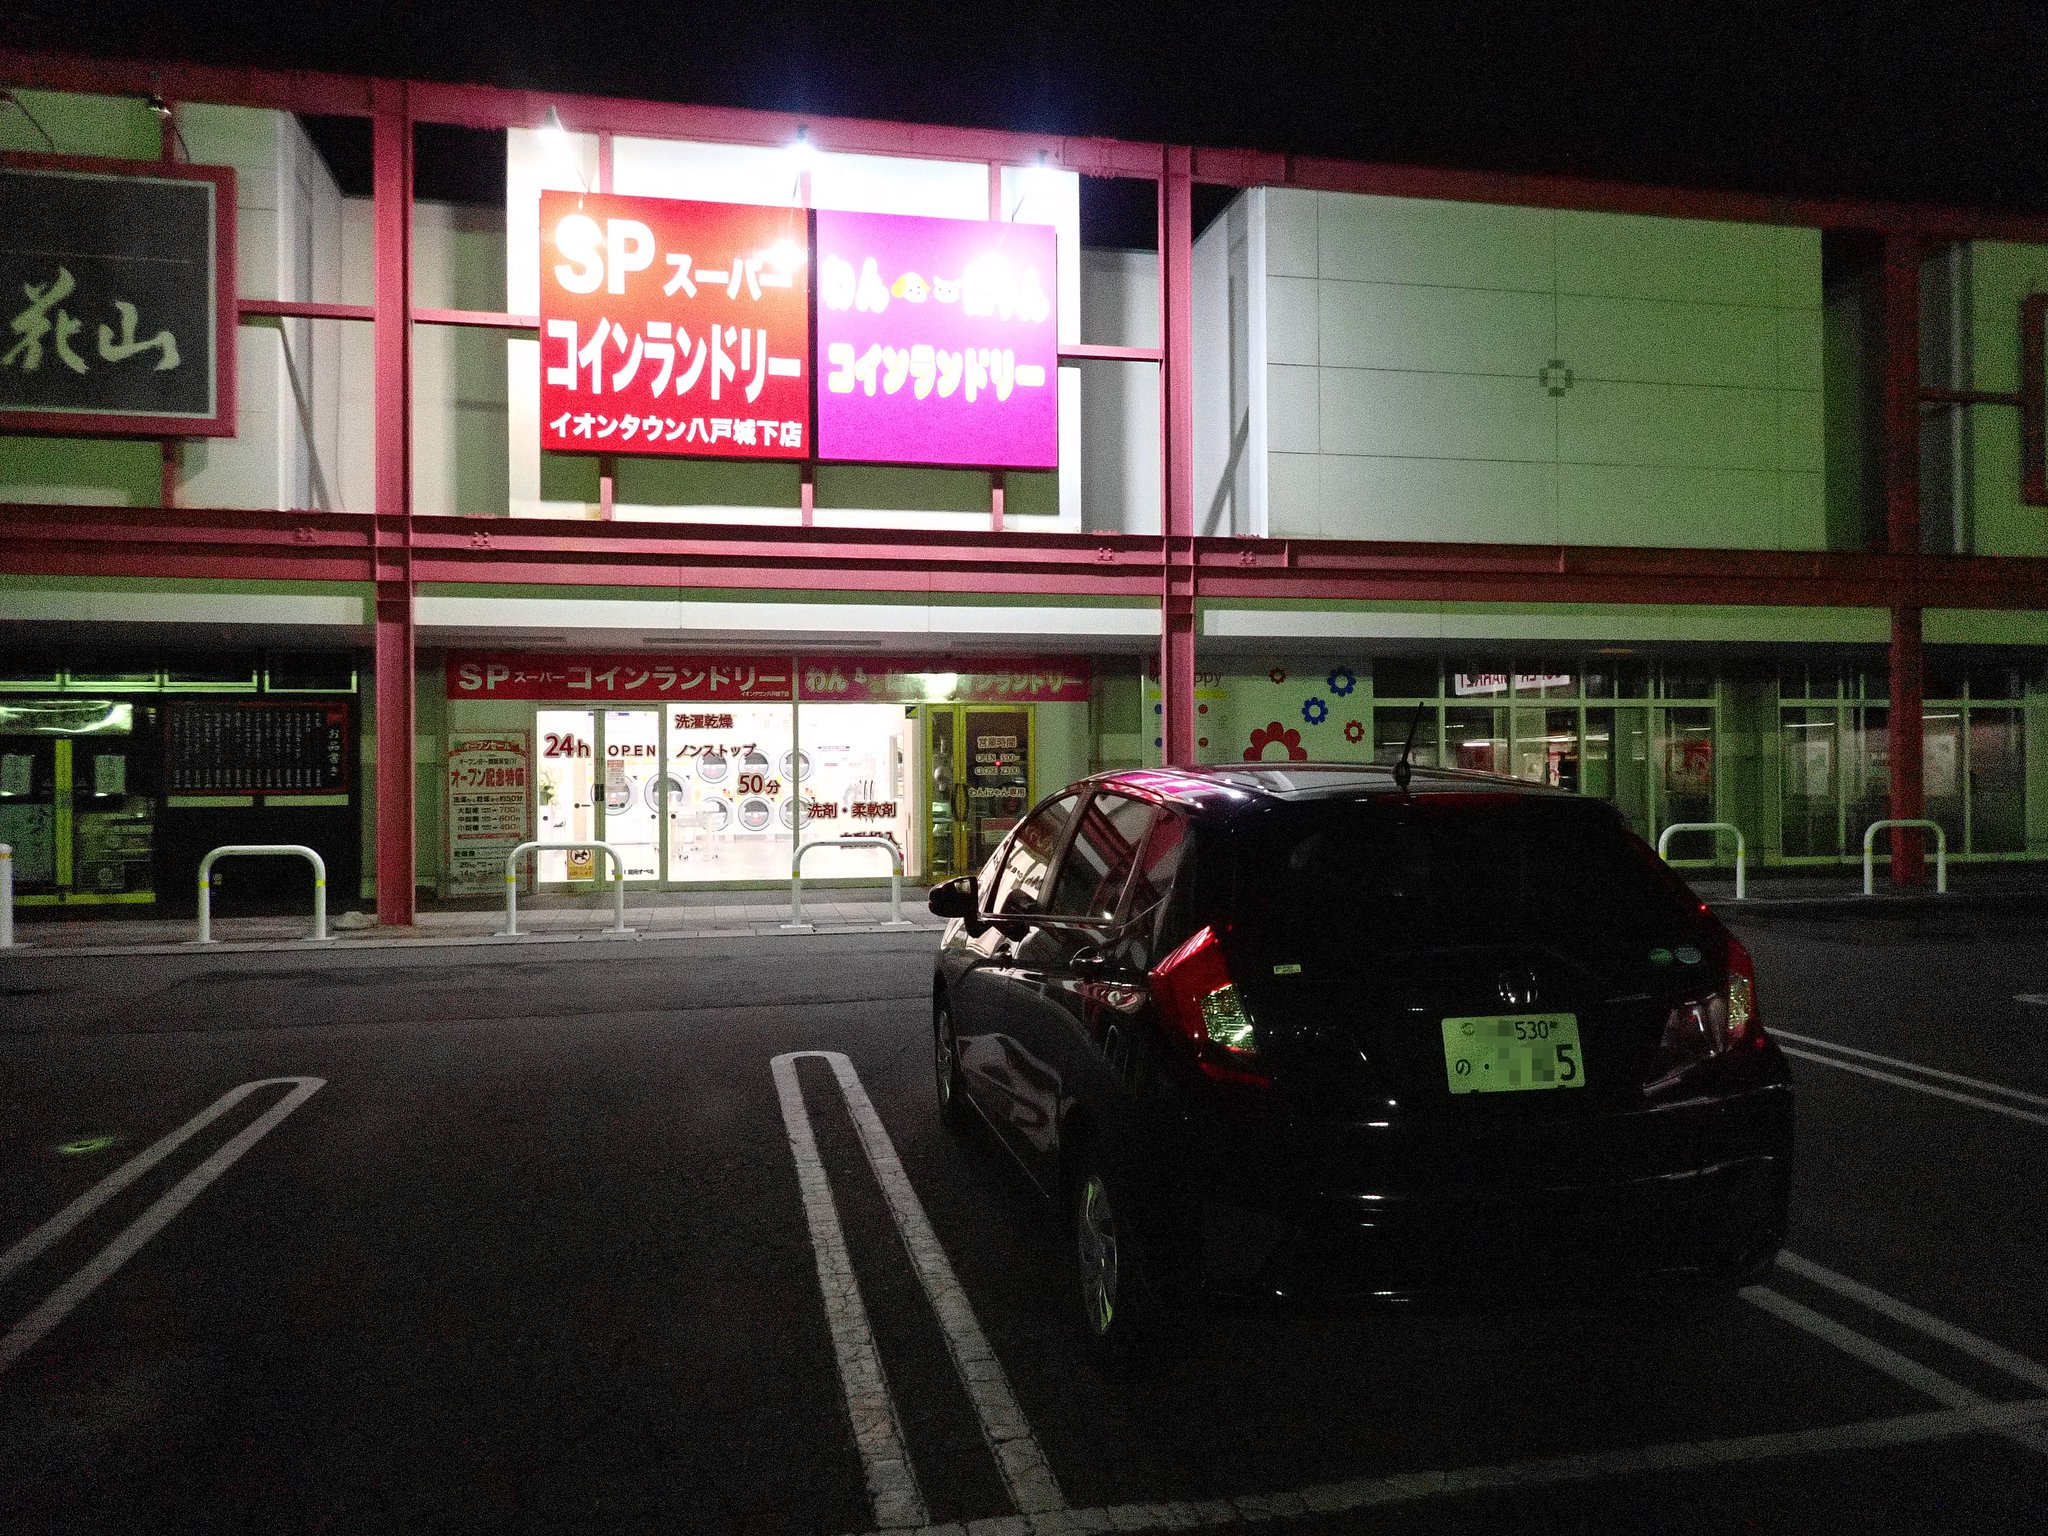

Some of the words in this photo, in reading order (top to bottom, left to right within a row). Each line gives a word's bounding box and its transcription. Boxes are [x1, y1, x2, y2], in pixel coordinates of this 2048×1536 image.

[554, 213, 656, 296] SP
[664, 251, 794, 301] スーパー
[547, 316, 801, 403] コインランドリー
[827, 341, 1047, 402] コインランドリー
[549, 411, 802, 448] イオンタウン八戸城下店
[458, 663, 509, 691] SP
[514, 671, 566, 684] スーパー
[567, 664, 787, 692] コインランドリー
[674, 713, 734, 730] 洗濯乾燥
[544, 732, 591, 758] 24h
[607, 744, 657, 758] OPEN
[675, 743, 757, 758] ノンストップ
[1514, 1020, 1549, 1040] 530
[1455, 1059, 1471, 1076] の
